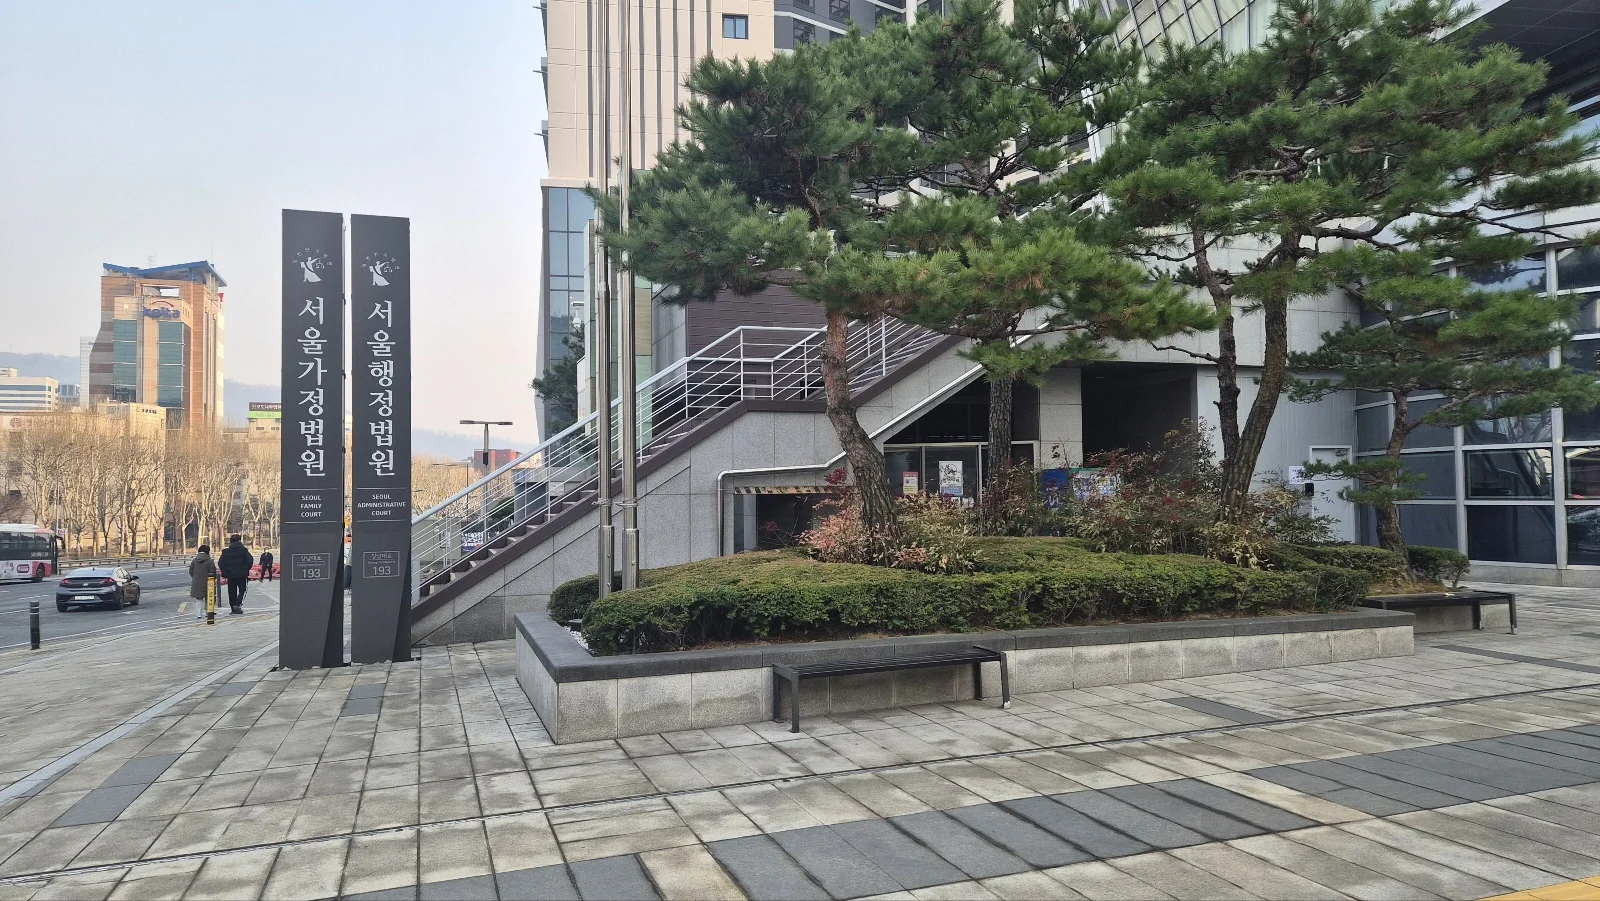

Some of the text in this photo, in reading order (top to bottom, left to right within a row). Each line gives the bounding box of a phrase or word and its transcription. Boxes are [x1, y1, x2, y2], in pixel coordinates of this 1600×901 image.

[297, 296, 328, 477] 서울가정법원
[366, 300, 396, 476] 서울행정법원
[302, 568, 321, 578] 193
[372, 565, 391, 576] 193
